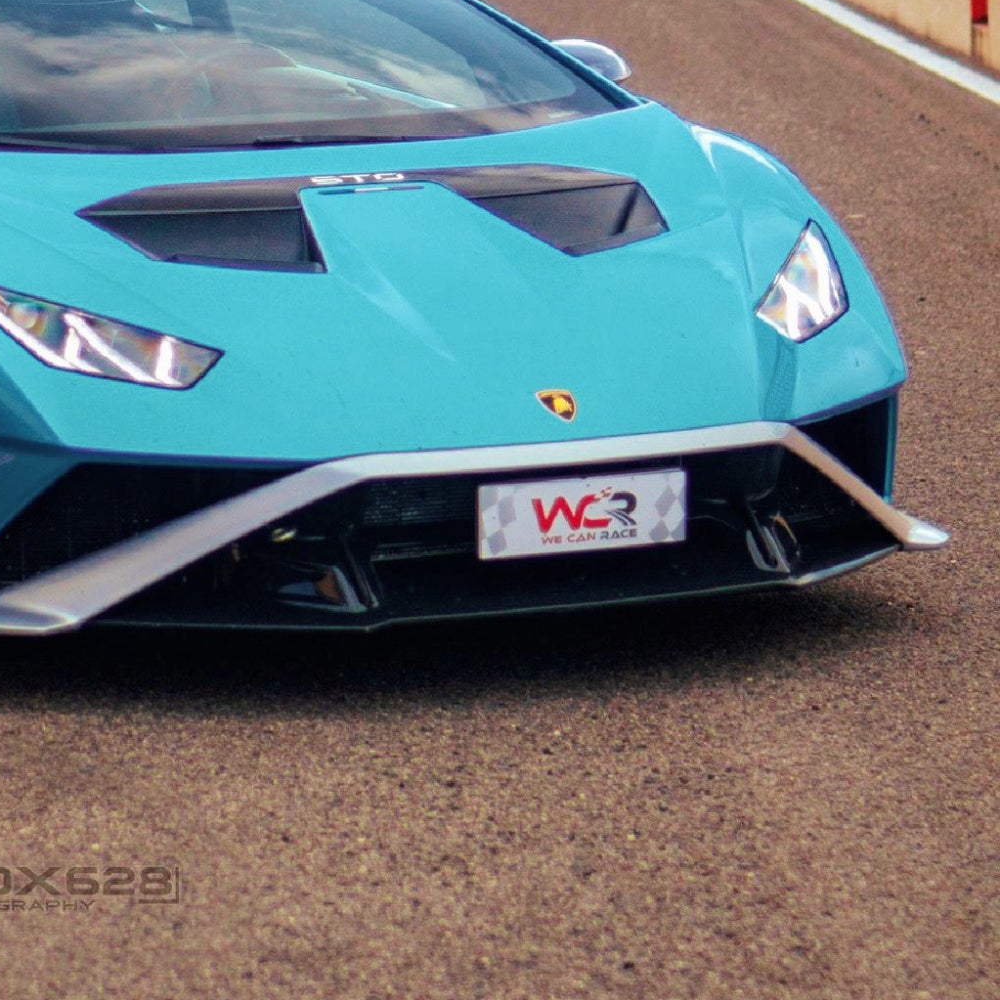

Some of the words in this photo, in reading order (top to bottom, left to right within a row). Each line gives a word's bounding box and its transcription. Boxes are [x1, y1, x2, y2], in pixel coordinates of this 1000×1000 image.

[532, 487, 637, 533] WCR
[541, 535, 562, 545] WE
[567, 533, 596, 543] CAN
[600, 528, 637, 540] RACE
